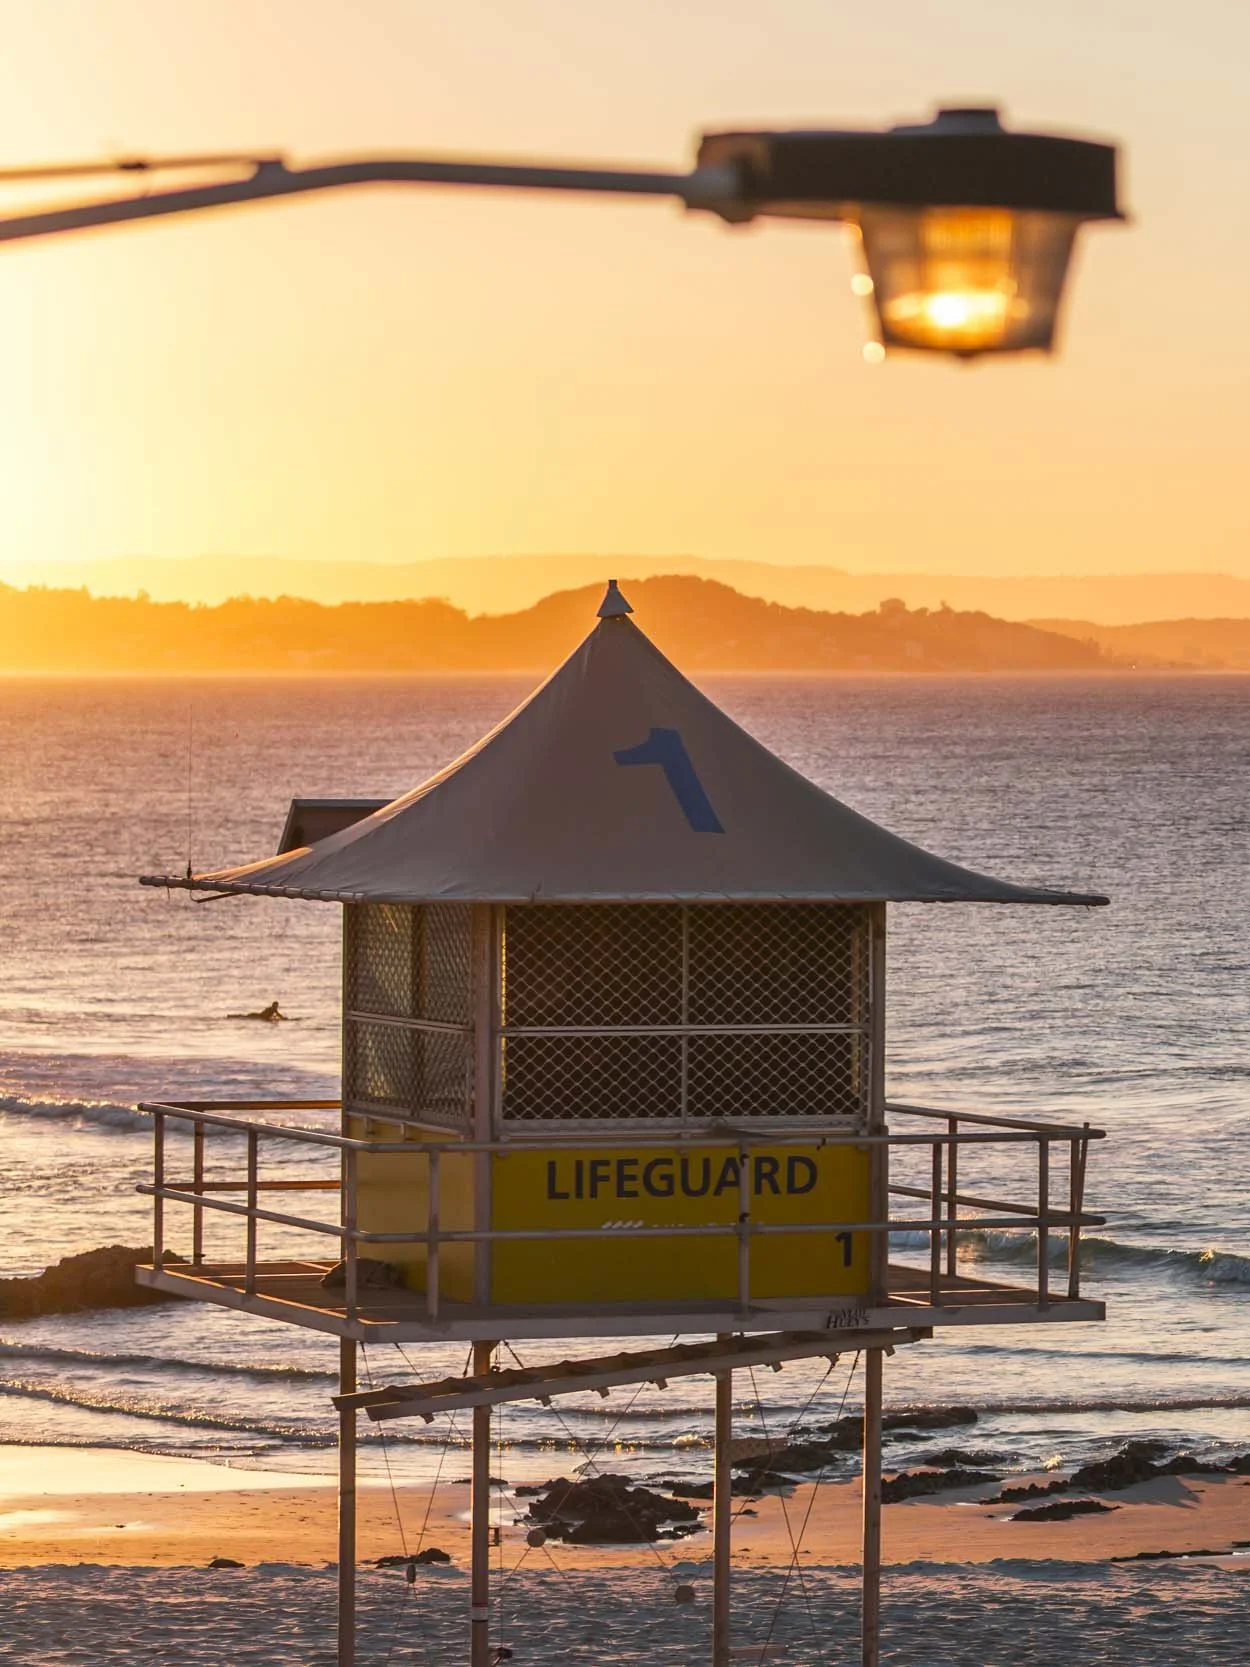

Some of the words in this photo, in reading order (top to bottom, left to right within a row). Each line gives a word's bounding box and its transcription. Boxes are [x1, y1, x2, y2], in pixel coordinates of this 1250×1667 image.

[613, 728, 726, 834] 1
[547, 1155, 818, 1200] LIFEGUARD
[834, 1231, 852, 1268] 1
